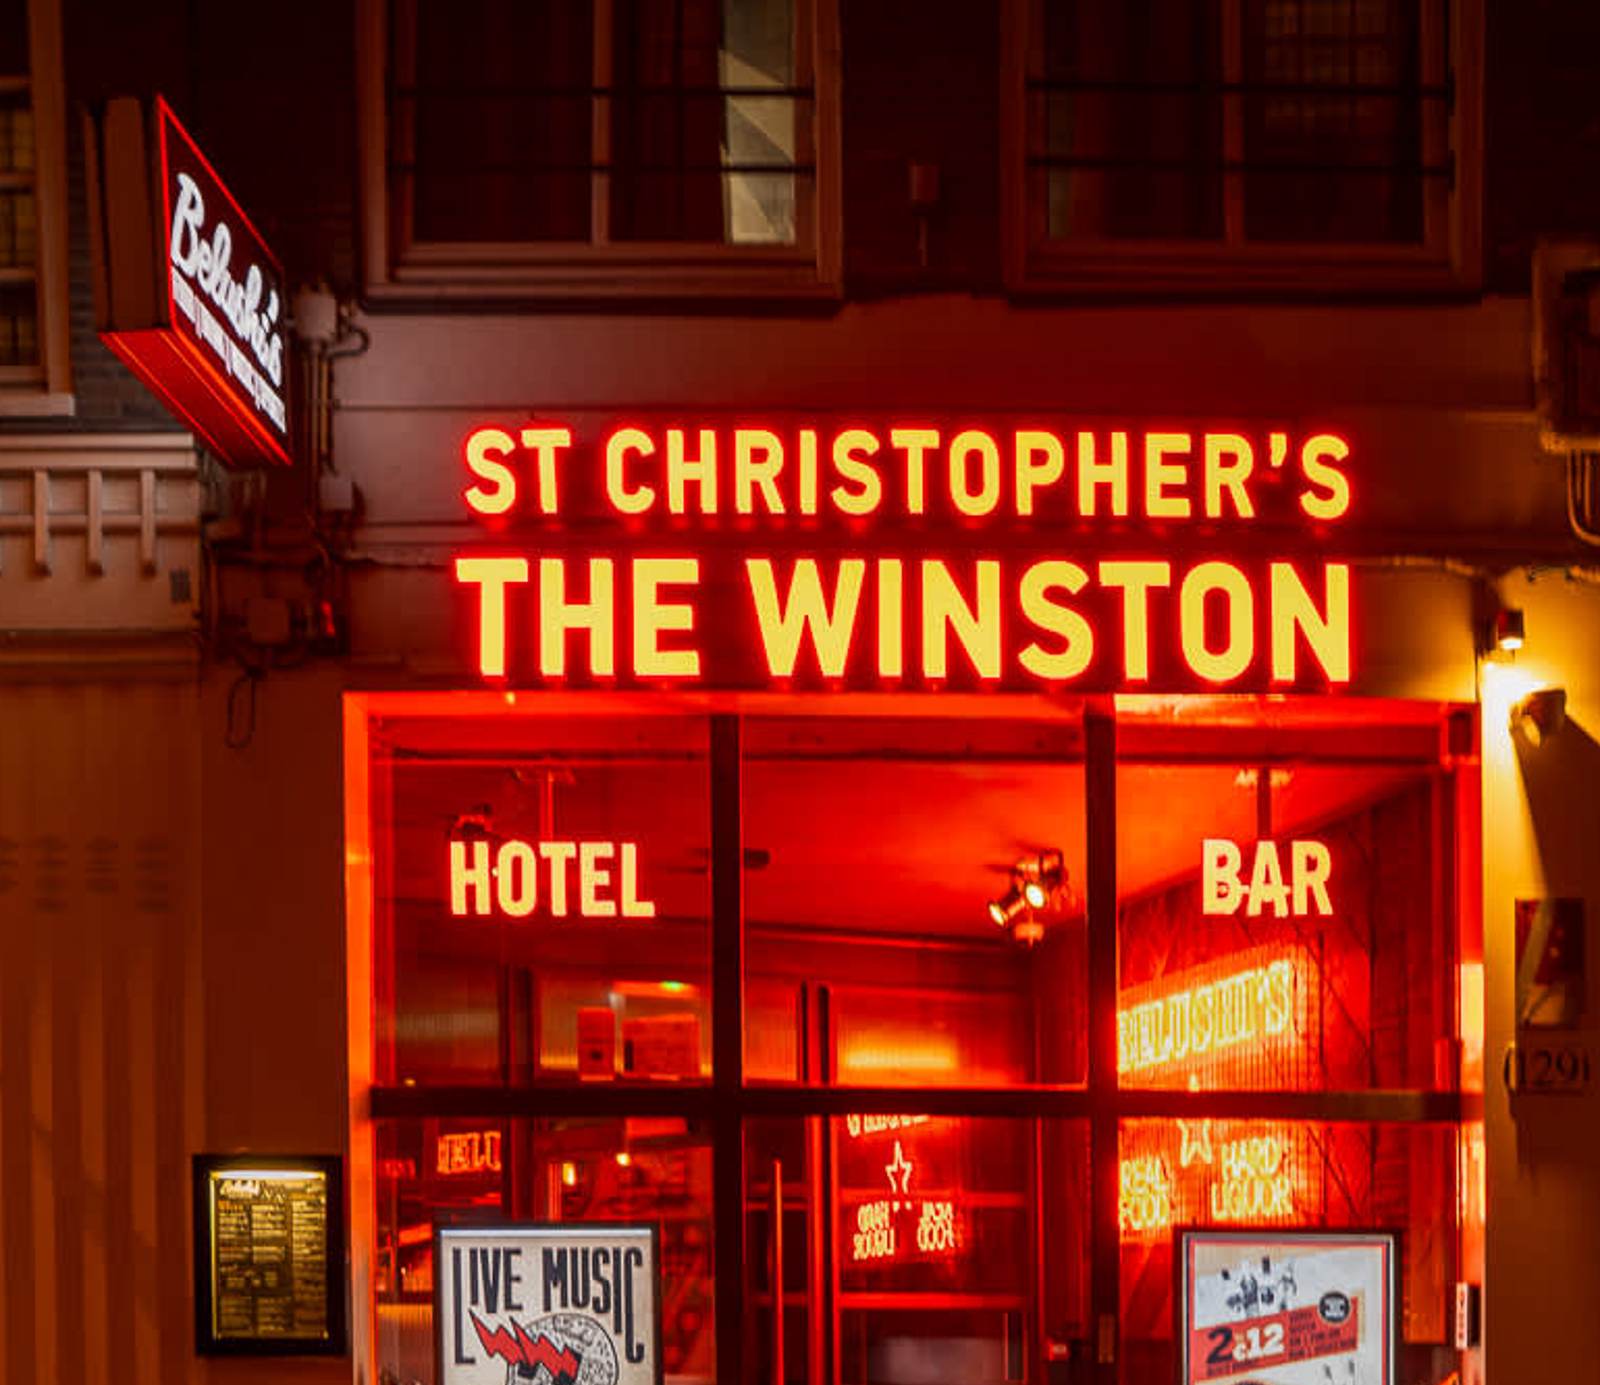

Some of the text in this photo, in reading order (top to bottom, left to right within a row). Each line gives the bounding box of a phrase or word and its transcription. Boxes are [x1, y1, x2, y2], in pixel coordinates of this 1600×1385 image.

[465, 428, 1350, 521] ST CHRISTOPHER'S
[456, 558, 1351, 683] THE WINSTON
[450, 840, 656, 917] HOTEL
[1203, 839, 1334, 917] BAR
[452, 1246, 523, 1364] LIVE
[542, 1246, 645, 1364] MUSIC
